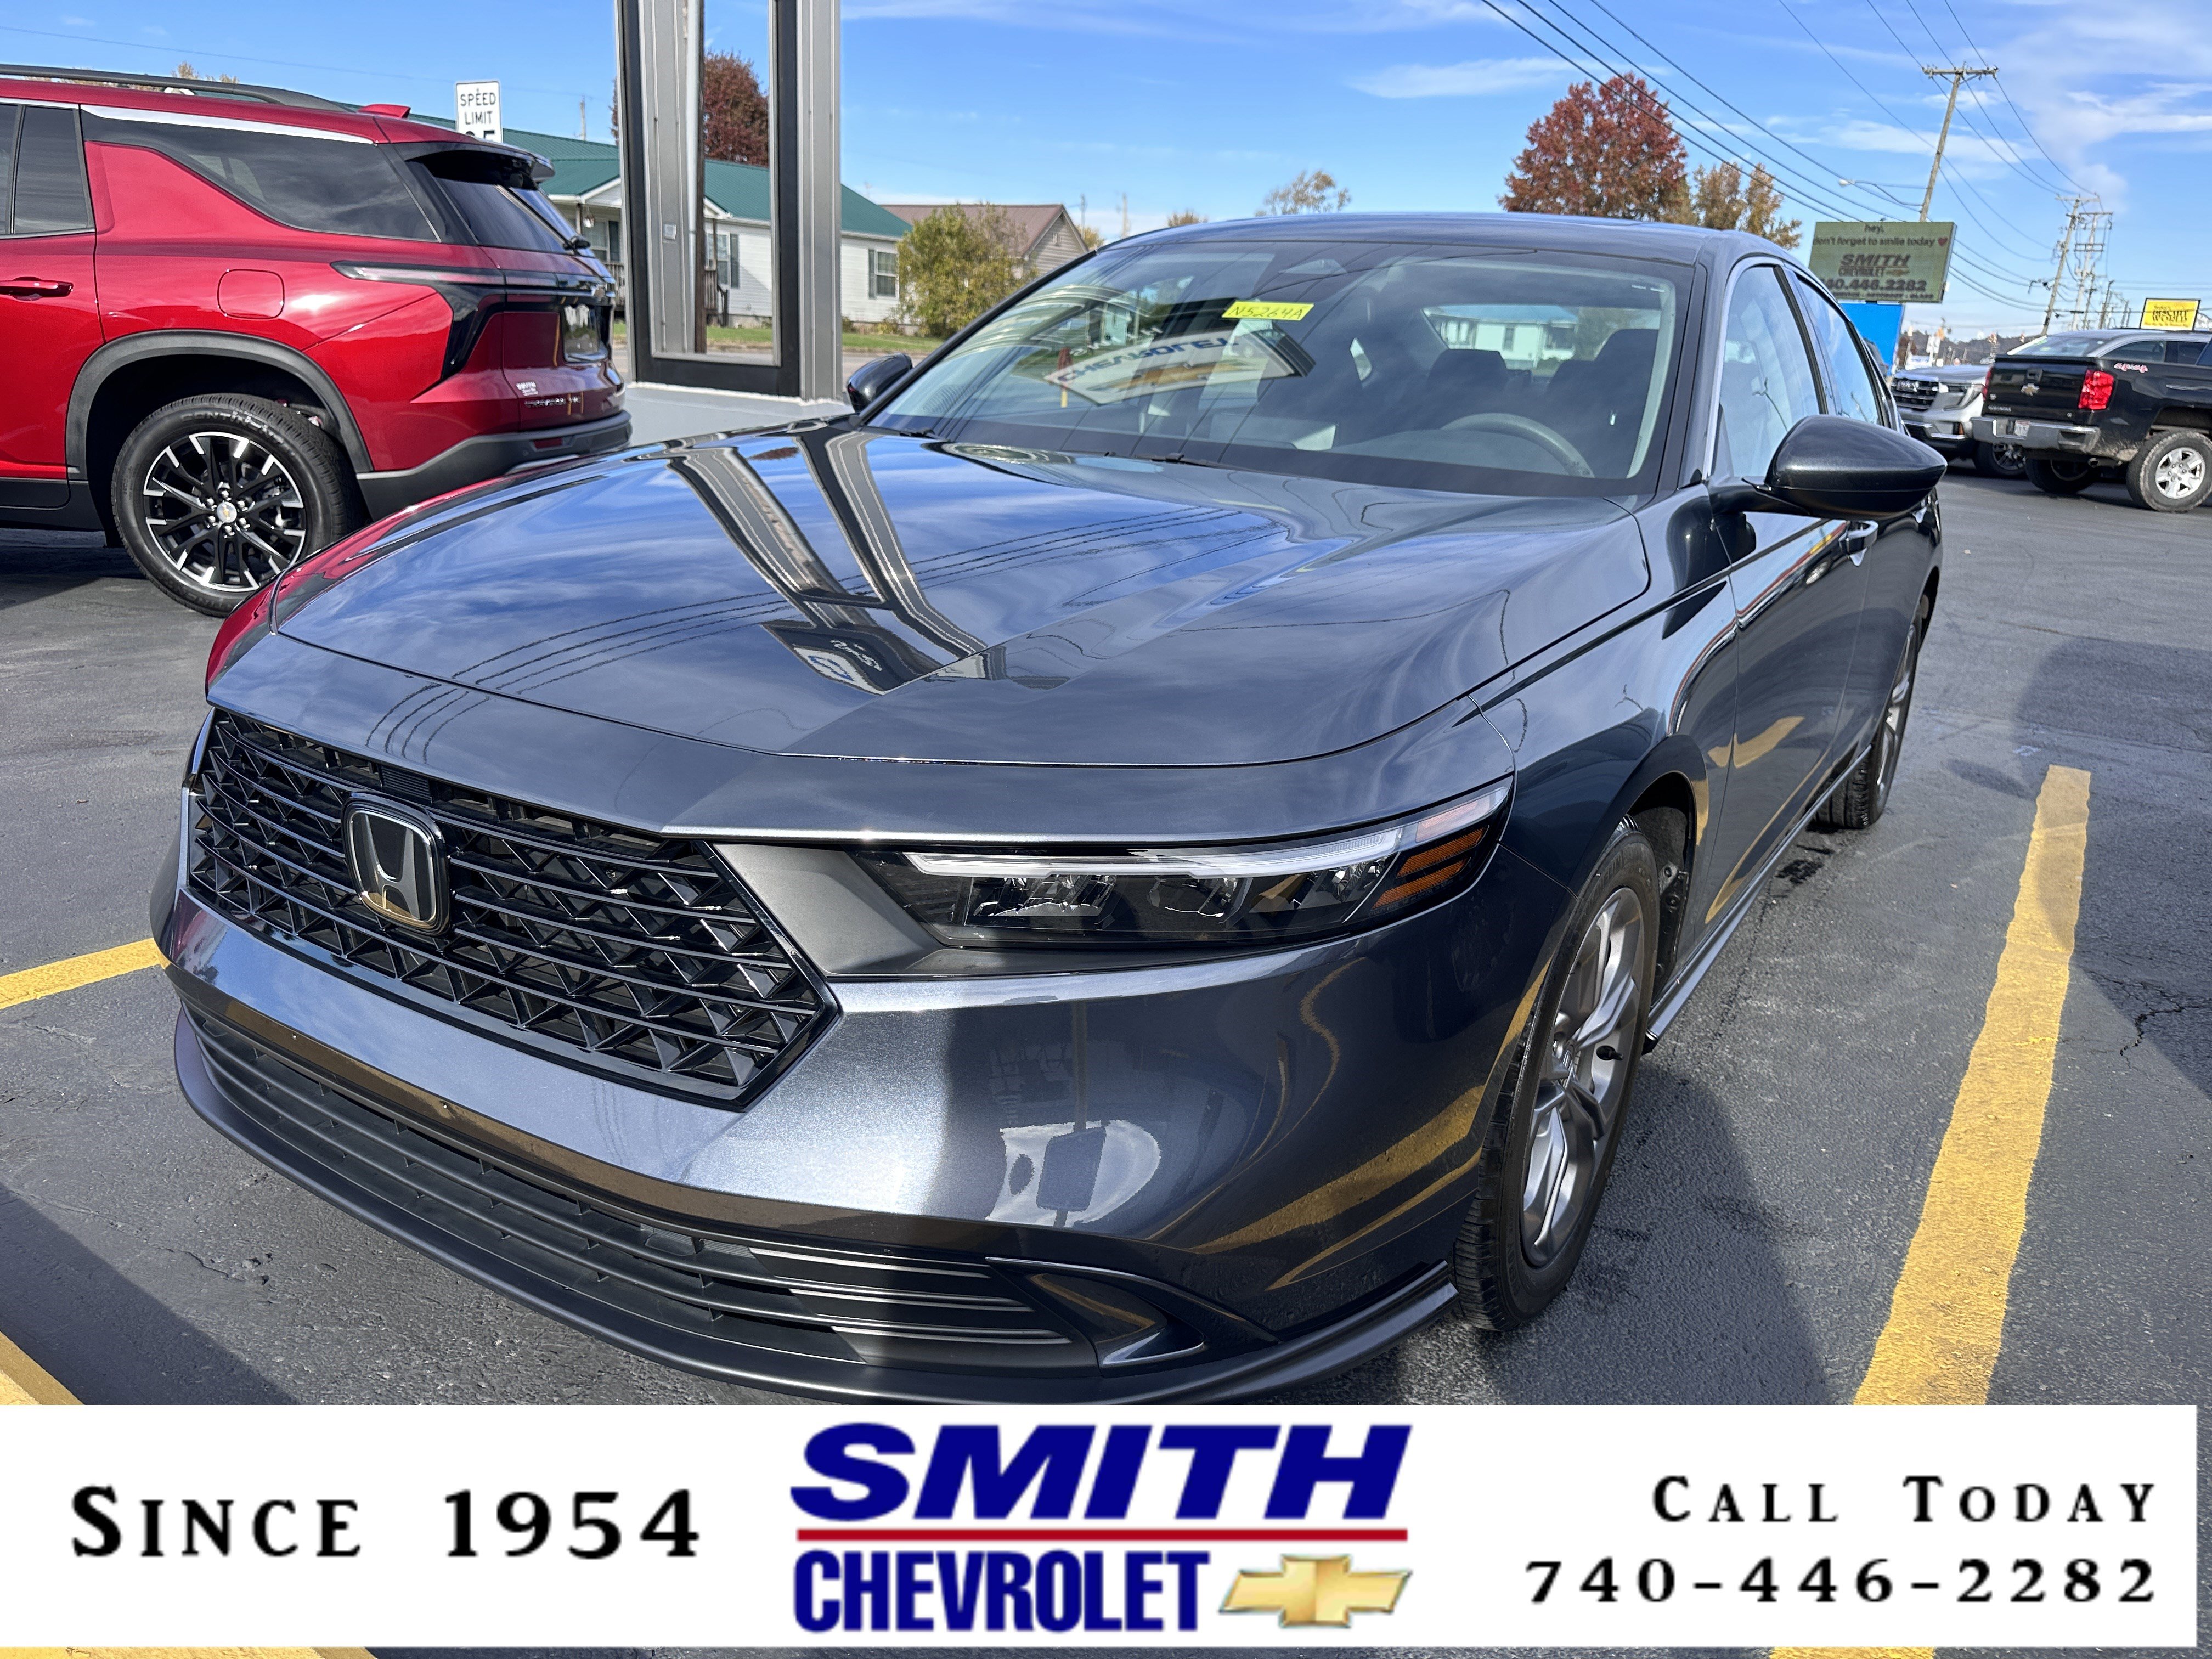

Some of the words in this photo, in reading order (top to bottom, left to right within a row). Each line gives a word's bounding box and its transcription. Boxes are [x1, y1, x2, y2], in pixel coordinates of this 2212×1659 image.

[460, 92, 496, 106] SPEED
[464, 111, 493, 125] LIMIT
[1837, 236, 1866, 247] forget
[1868, 237, 1877, 245] to
[1880, 236, 1904, 245] smile
[1907, 237, 1936, 247] today
[1840, 253, 1911, 266] SMITH
[1228, 306, 1308, 319] N5264A
